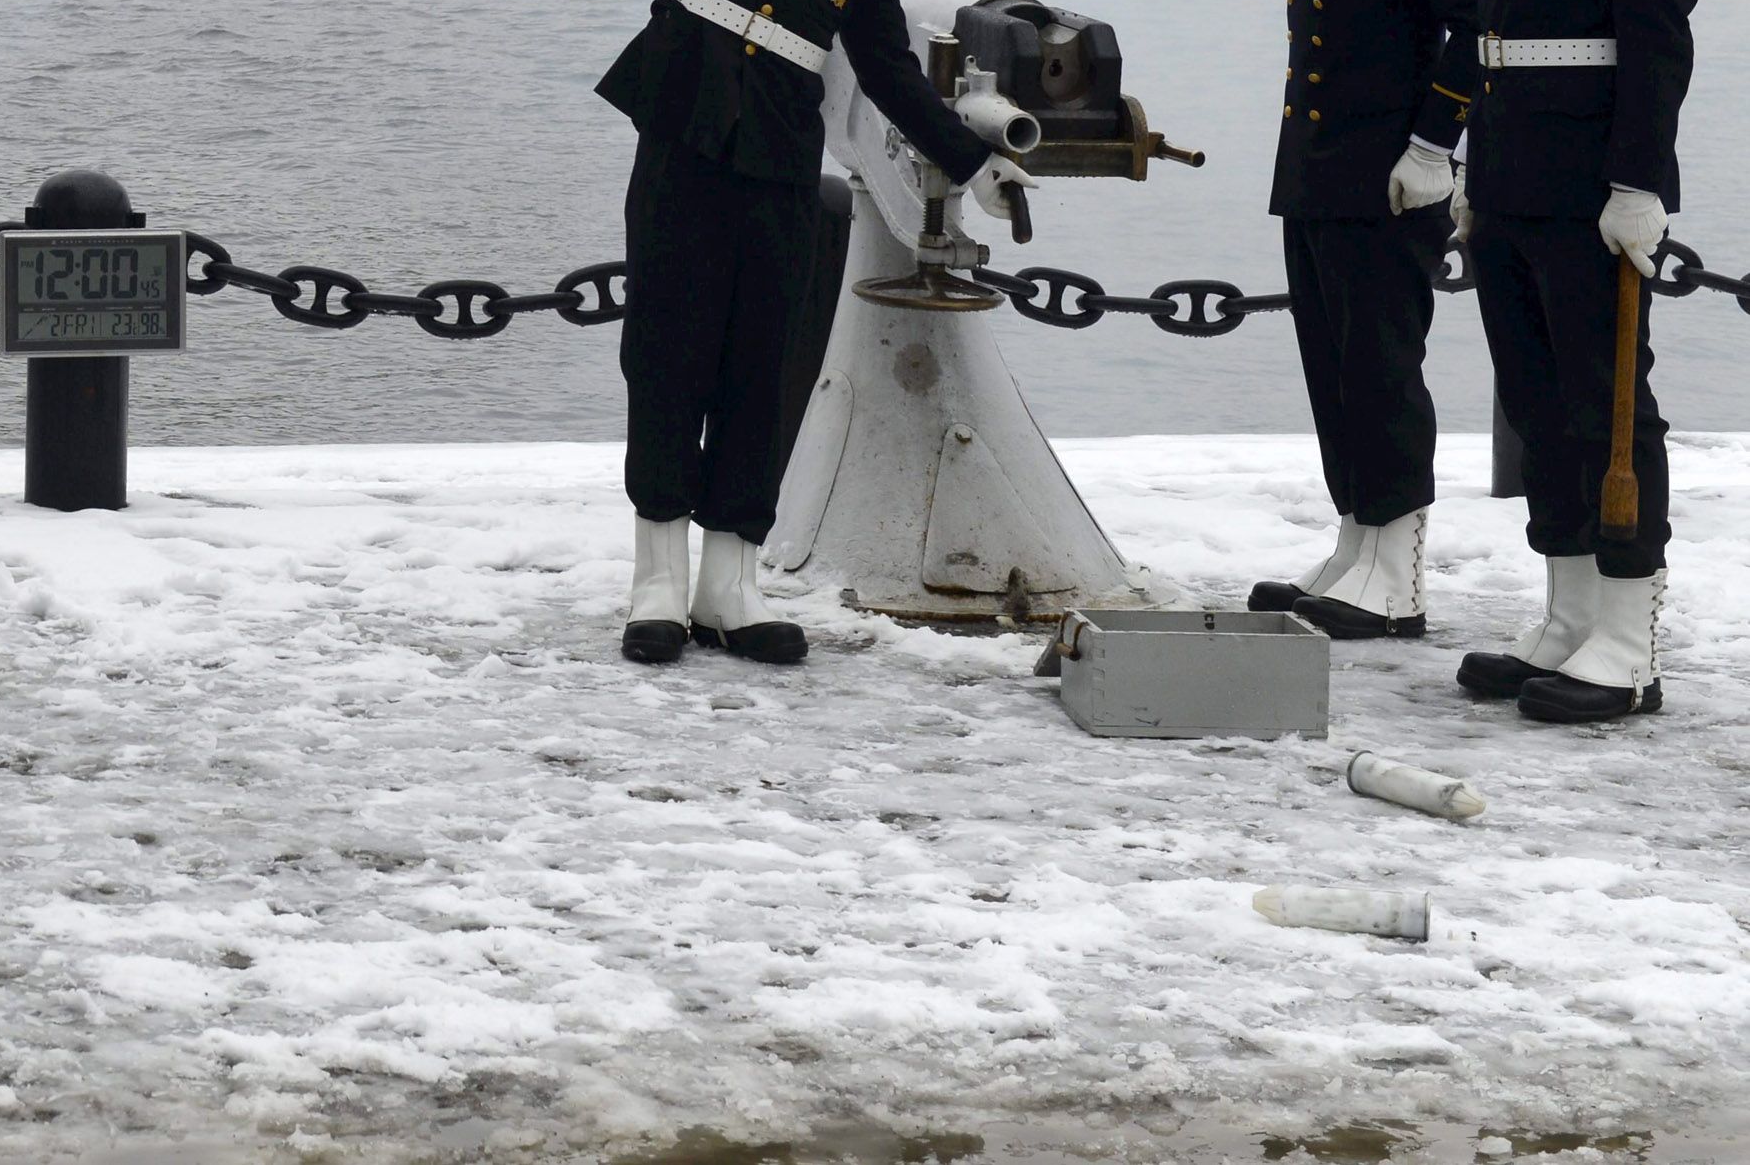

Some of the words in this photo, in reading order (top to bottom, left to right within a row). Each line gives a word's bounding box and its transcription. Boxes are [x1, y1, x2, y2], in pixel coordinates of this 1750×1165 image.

[20, 260, 34, 268] PM
[35, 248, 138, 301] 12:00
[140, 279, 160, 298] 45
[63, 314, 95, 335] FRI
